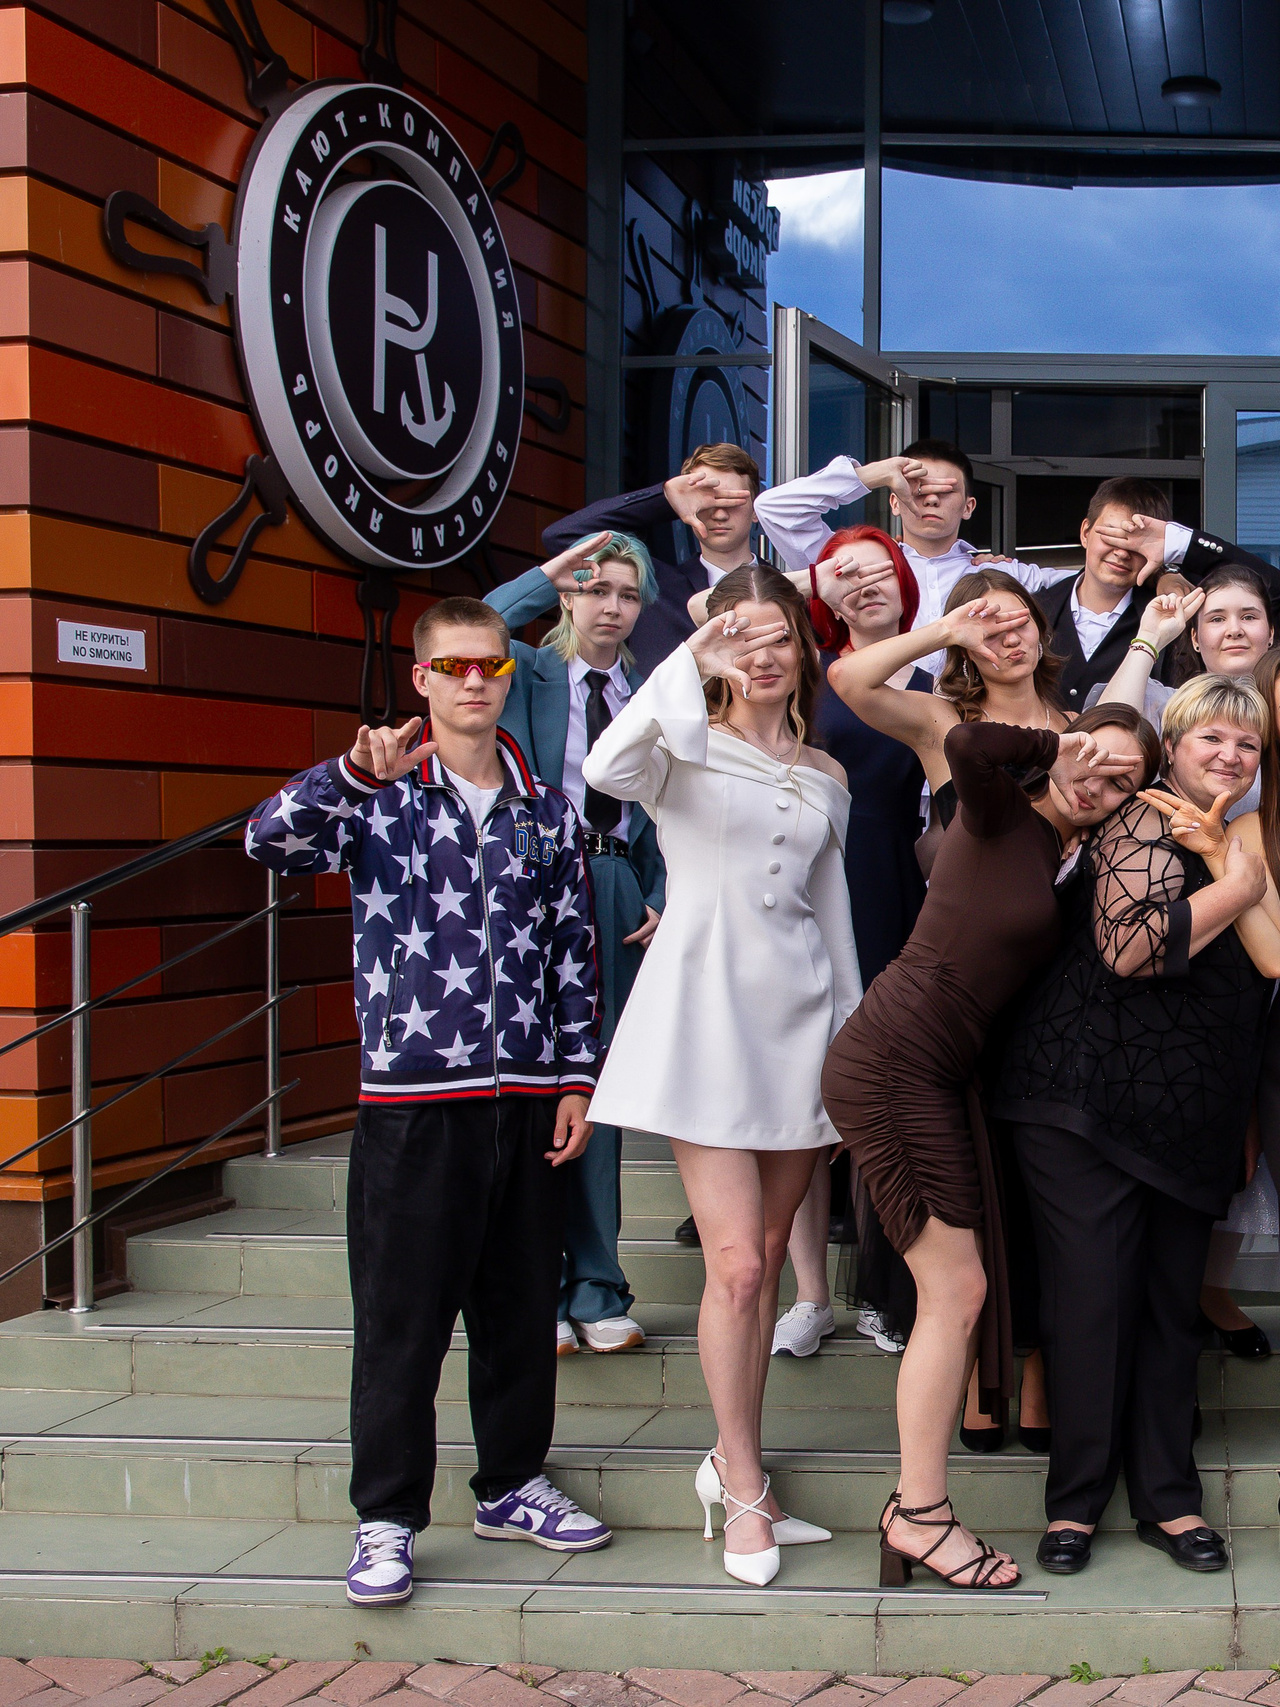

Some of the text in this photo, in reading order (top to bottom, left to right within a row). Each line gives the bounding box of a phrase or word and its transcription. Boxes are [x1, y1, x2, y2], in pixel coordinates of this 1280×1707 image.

[283, 102, 515, 330] КАЮТ-КОМПАНИЯ
[293, 373, 508, 558] БРОСАЙ ЯКОРЬ
[73, 646, 132, 662] NO SMOKING
[75, 630, 129, 646] НЕ КУРИТЬ!
[515, 829, 555, 867] D&G
